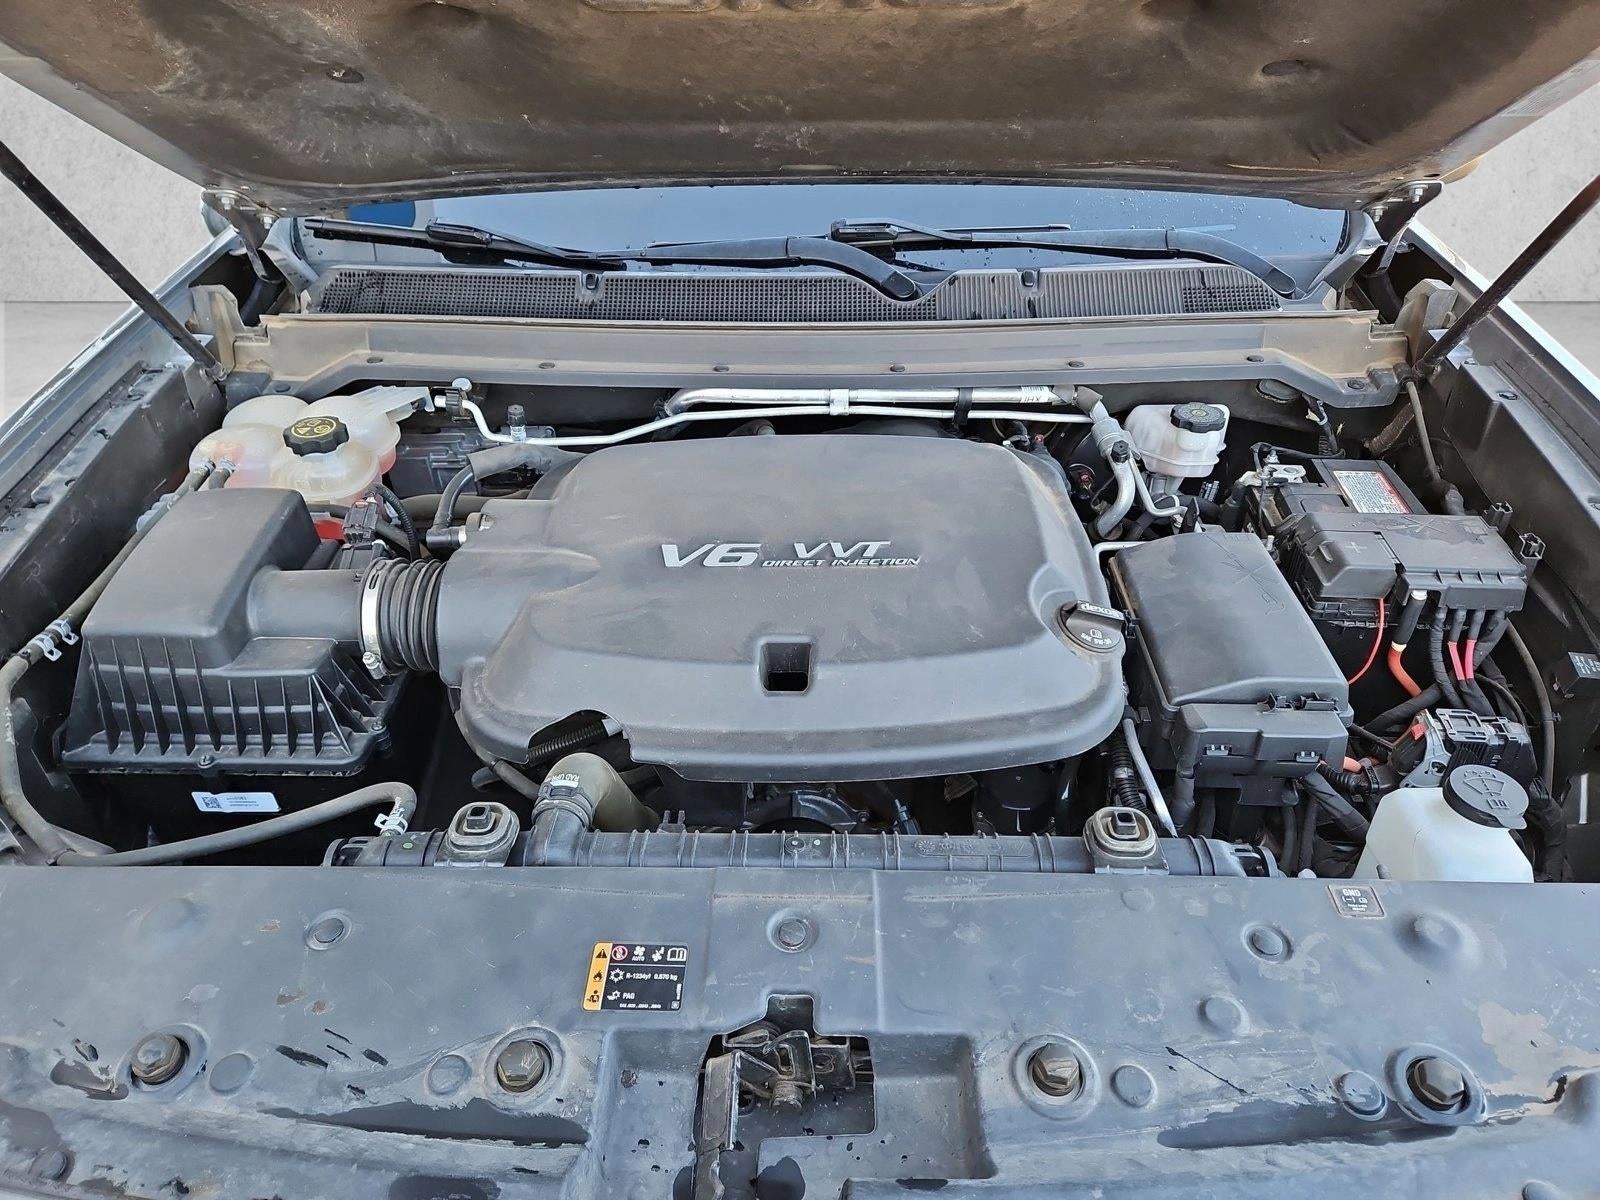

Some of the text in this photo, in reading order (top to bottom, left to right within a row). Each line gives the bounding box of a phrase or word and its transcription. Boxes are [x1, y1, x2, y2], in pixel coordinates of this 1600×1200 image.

[793, 541, 891, 559] VVT
[661, 543, 762, 568] V6
[761, 558, 920, 567] DIRECT INJECTION
[565, 773, 580, 782] RAD
[1342, 888, 1362, 897] GND
[625, 972, 651, 981] R-1234yf
[670, 973, 679, 982] kg
